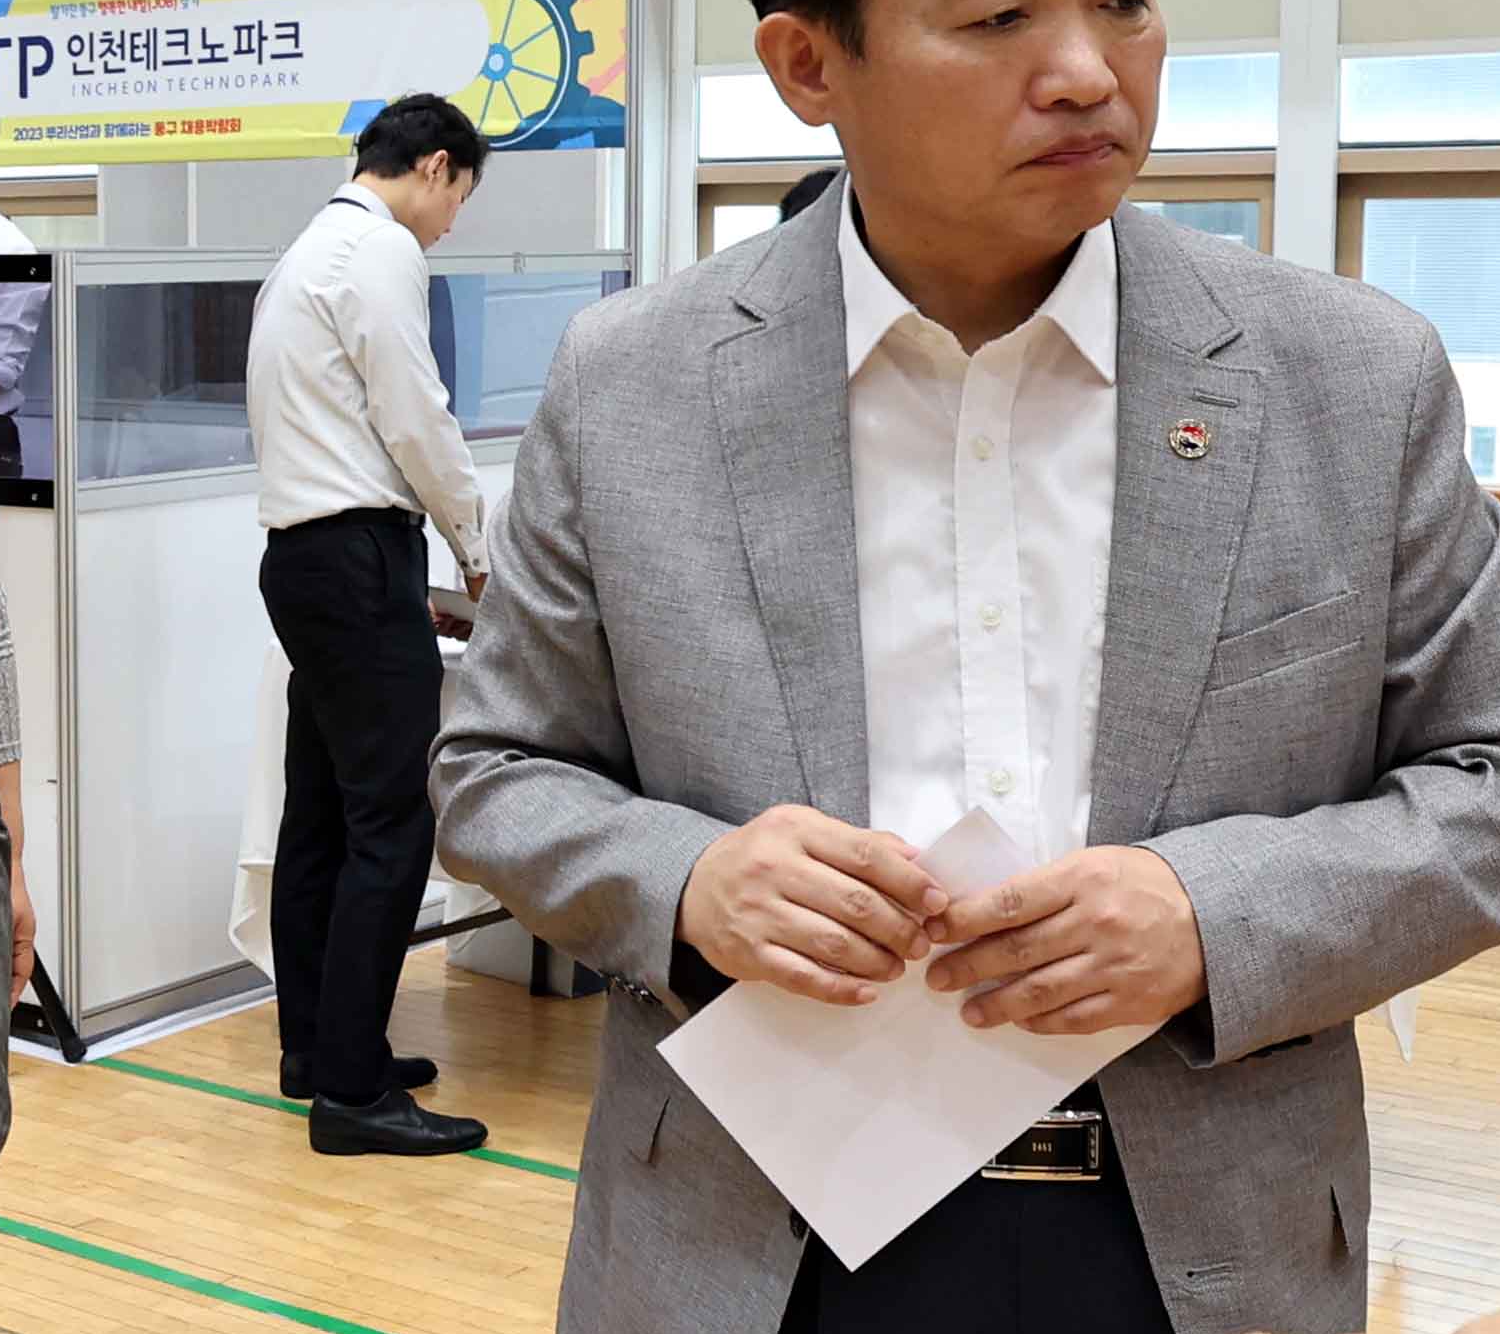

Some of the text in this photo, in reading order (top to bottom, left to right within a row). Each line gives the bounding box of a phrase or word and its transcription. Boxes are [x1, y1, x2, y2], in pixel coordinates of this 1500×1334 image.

[66, 19, 304, 76] 인천테크노파크
[71, 70, 301, 98] INCHEON TECHNOPARK
